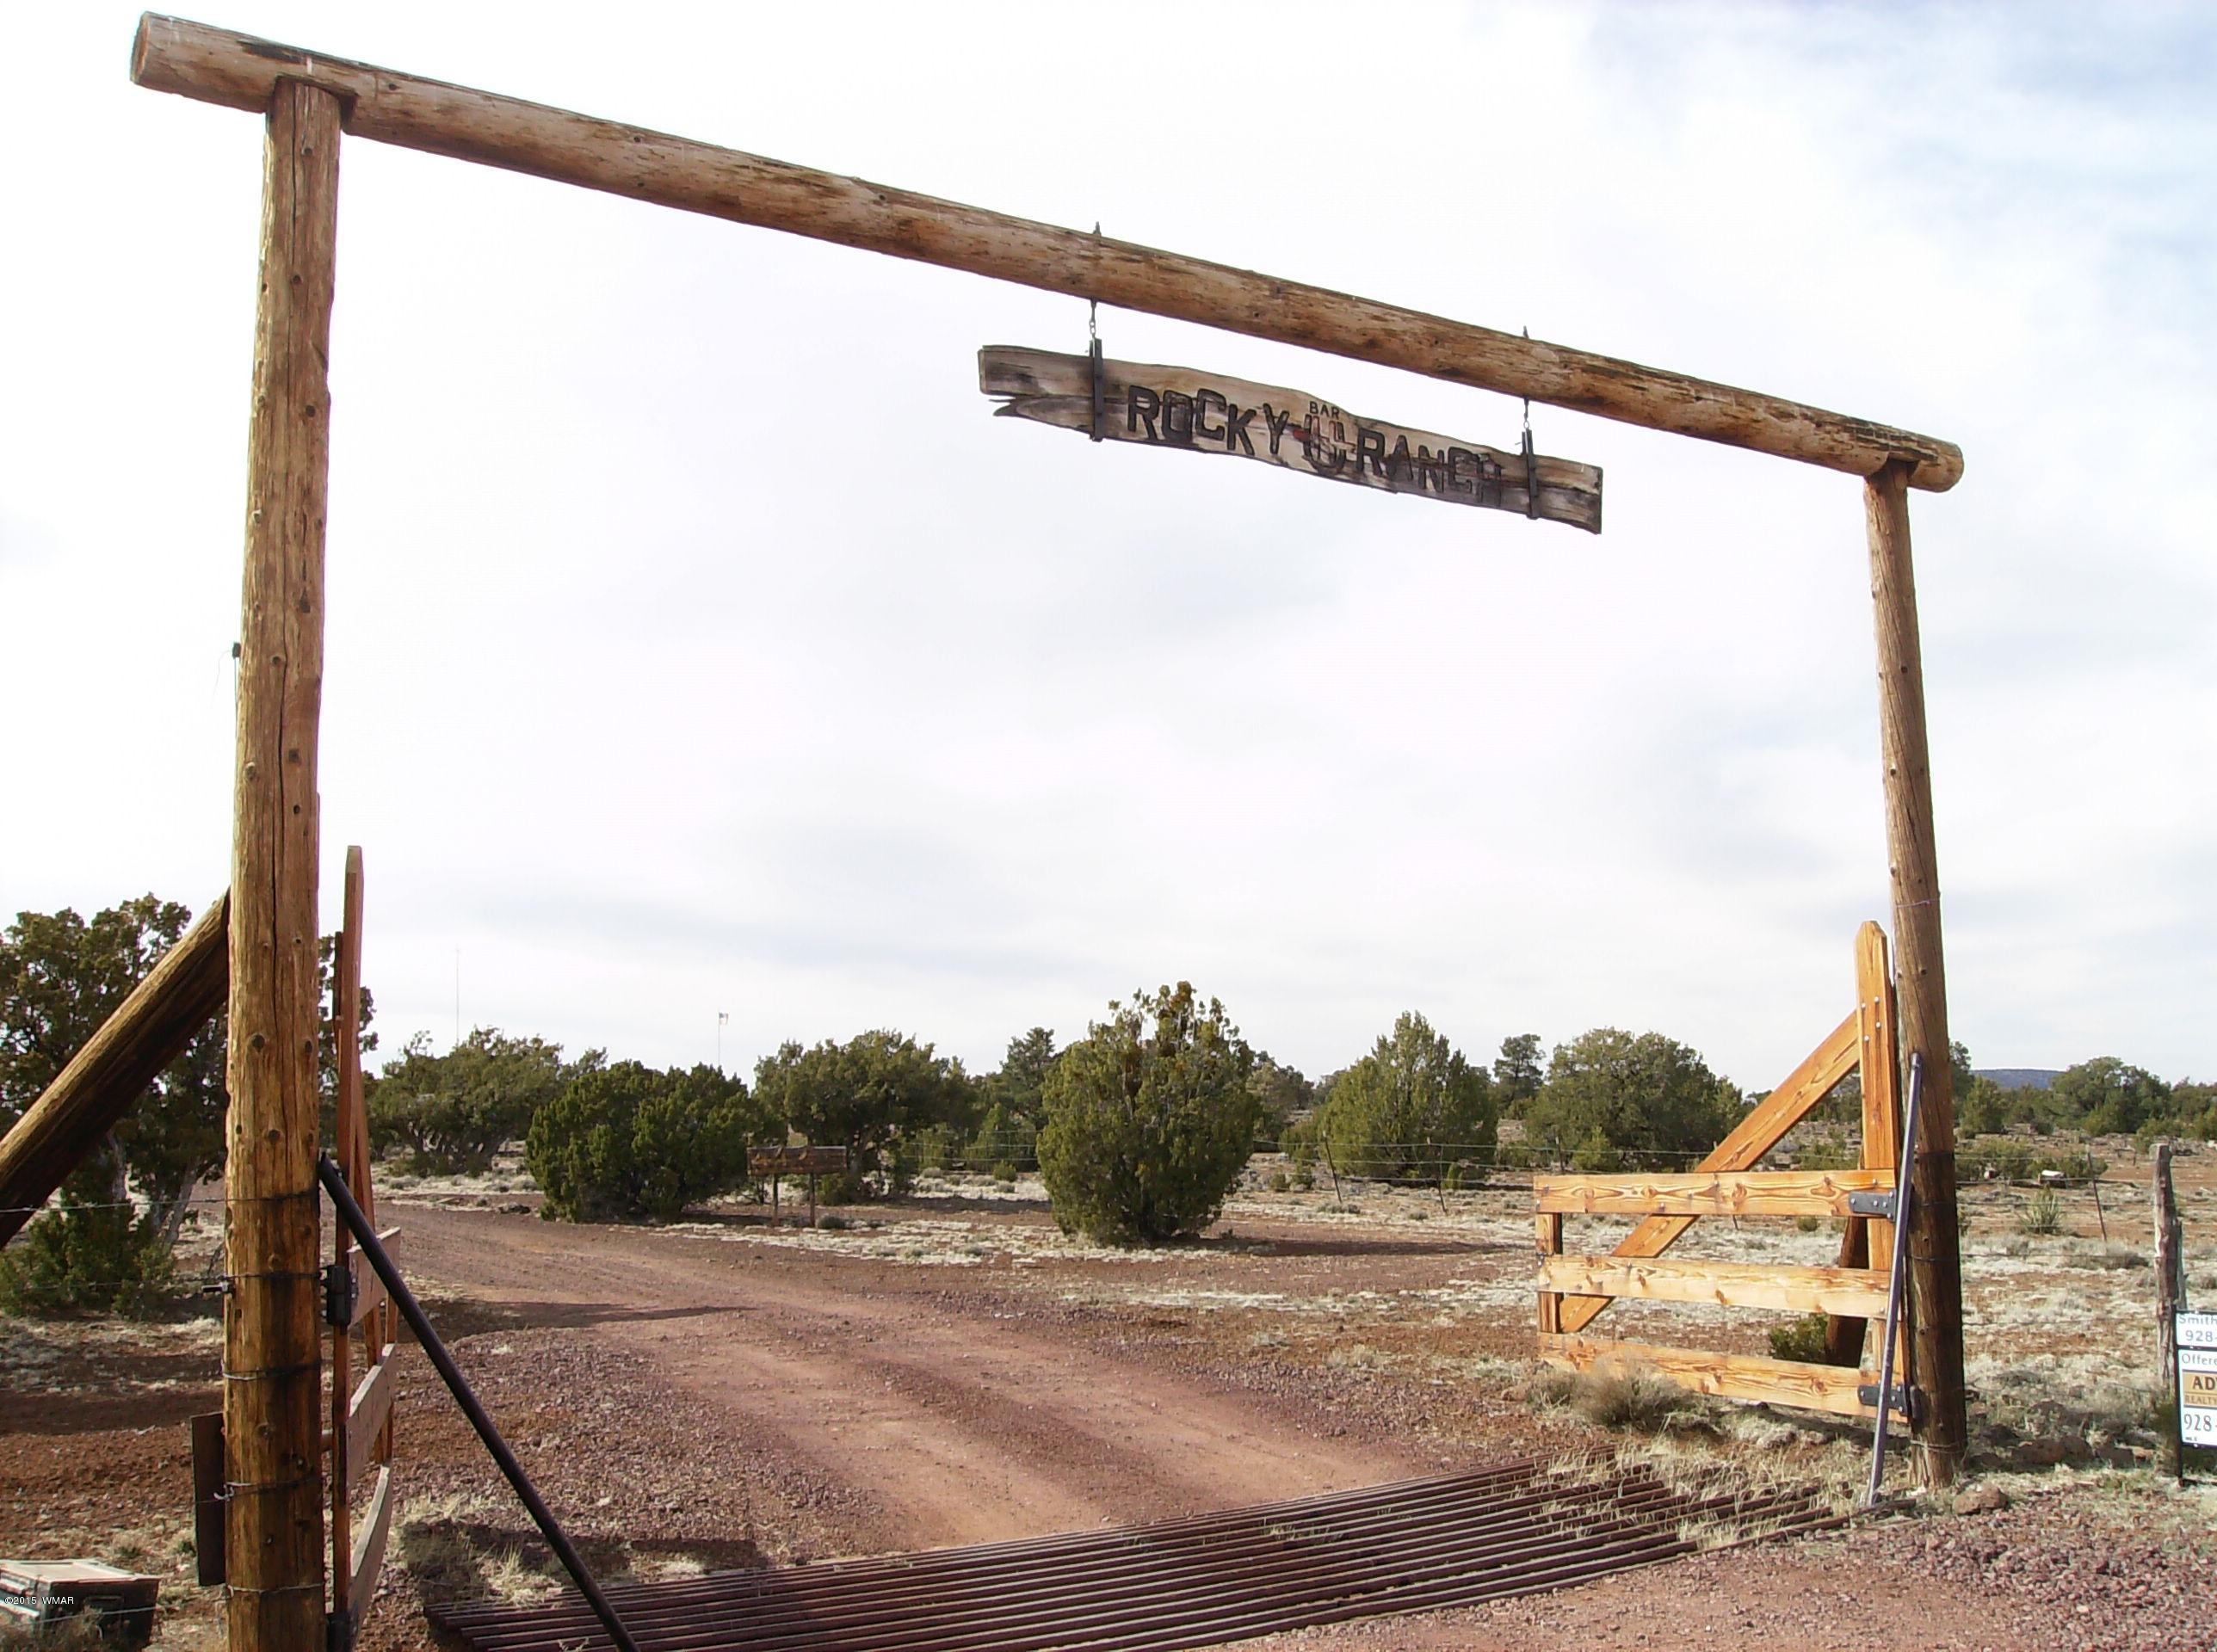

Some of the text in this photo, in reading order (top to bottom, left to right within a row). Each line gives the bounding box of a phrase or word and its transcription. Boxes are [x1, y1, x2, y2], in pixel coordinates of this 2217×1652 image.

[1309, 401, 1340, 420] BAR
[1127, 385, 1289, 456] ROCKY
[1357, 428, 1502, 507] RANCH
[2192, 1376, 2217, 1390] AD
